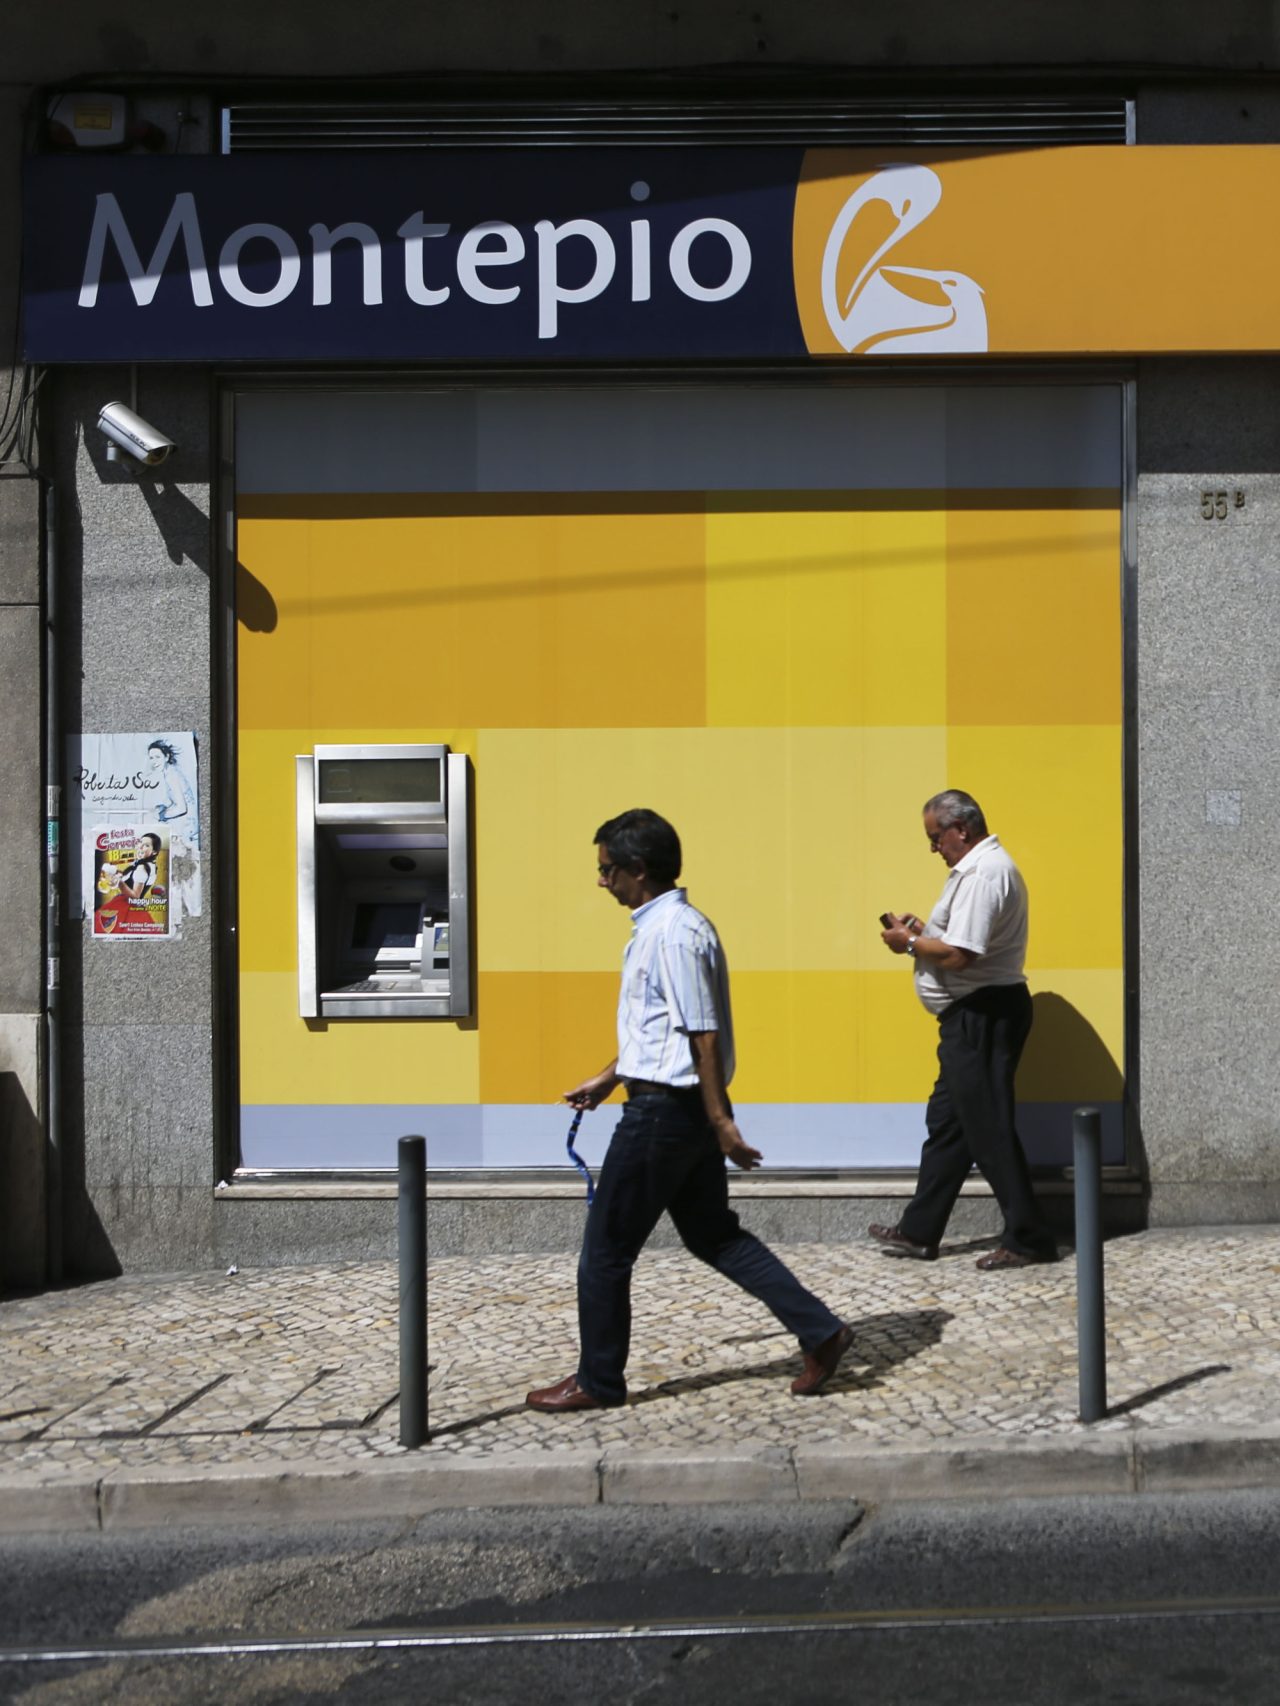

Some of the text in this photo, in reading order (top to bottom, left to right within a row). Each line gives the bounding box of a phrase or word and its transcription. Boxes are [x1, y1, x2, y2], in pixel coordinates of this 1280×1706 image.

[78, 181, 752, 339] Montepio
[1201, 491, 1245, 520] 55 B
[128, 897, 150, 906] happy
